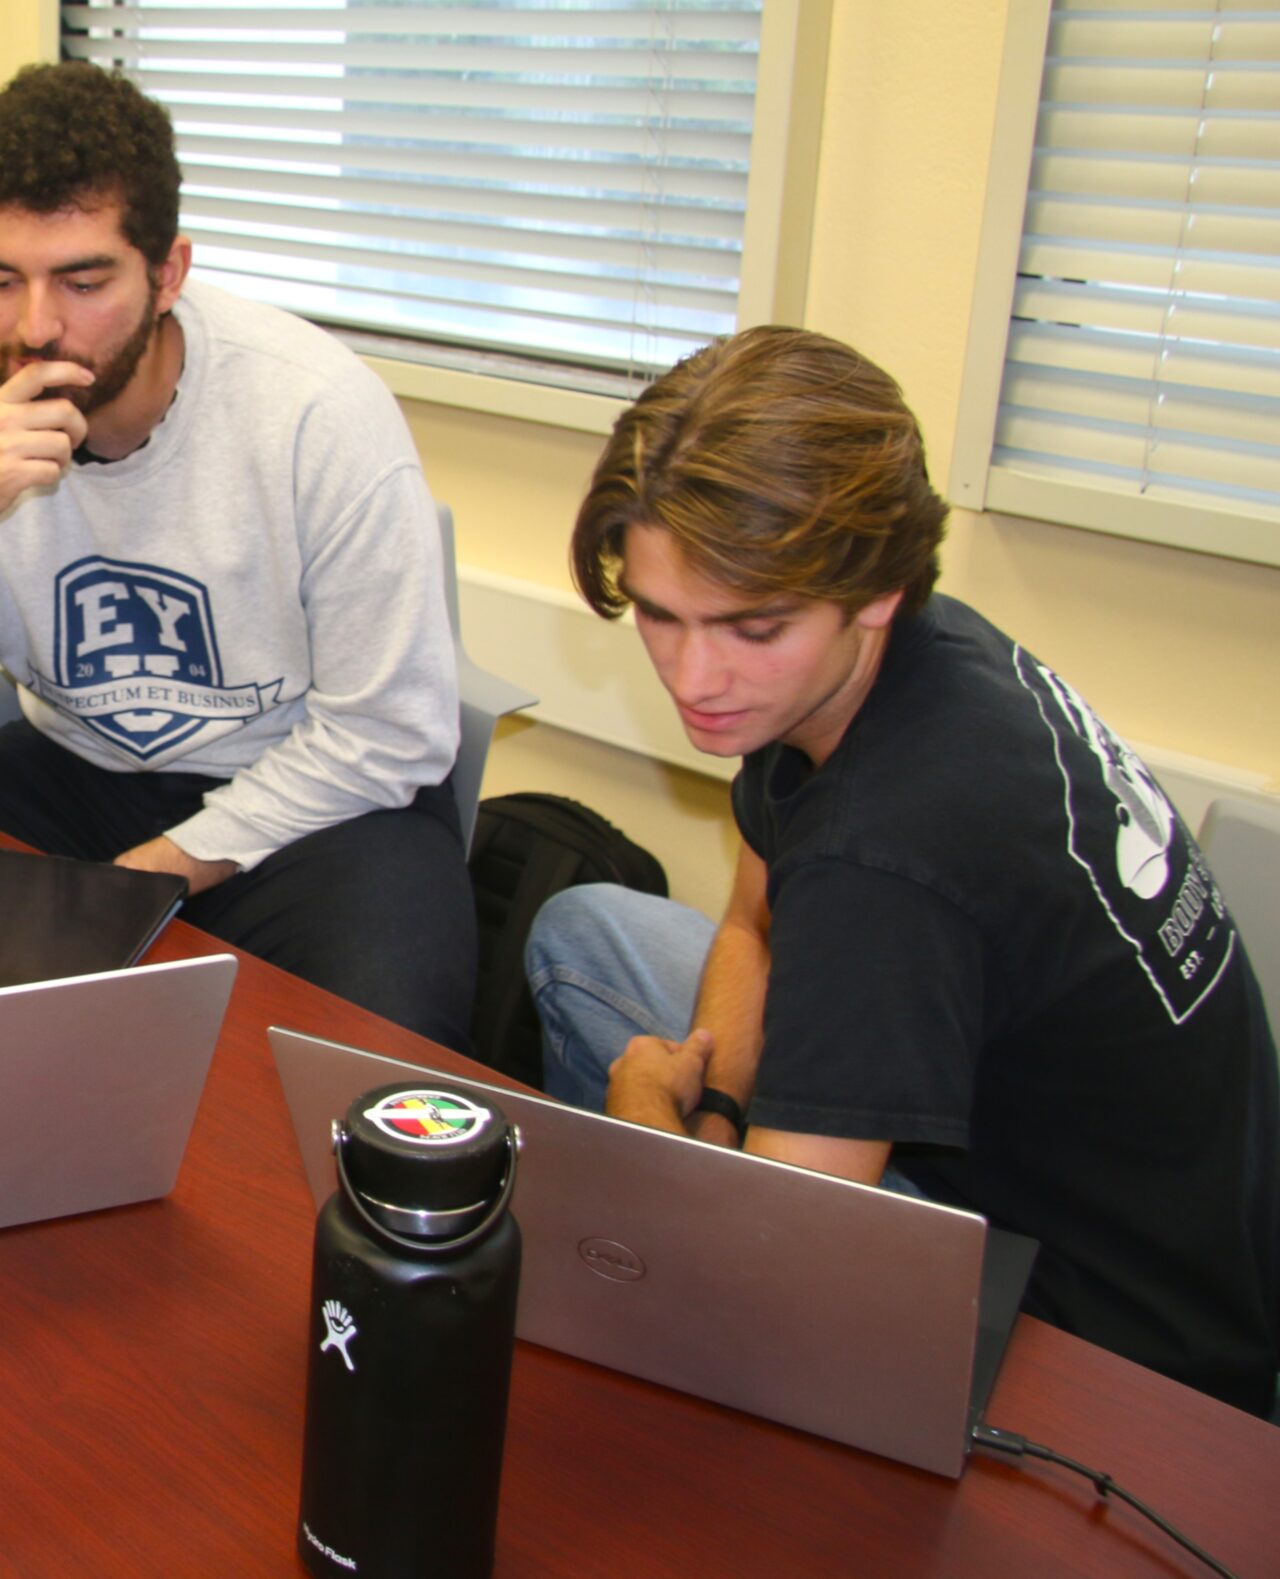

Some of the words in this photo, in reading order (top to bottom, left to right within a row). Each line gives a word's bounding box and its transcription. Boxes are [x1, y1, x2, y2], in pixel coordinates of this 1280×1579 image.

[74, 582, 191, 658] EY
[75, 663, 94, 678] 20
[189, 663, 206, 677] 04
[44, 685, 141, 709] PECTUM
[147, 686, 172, 700] ET
[177, 690, 256, 709] BUSINUS
[324, 1545, 357, 1571] Flask
